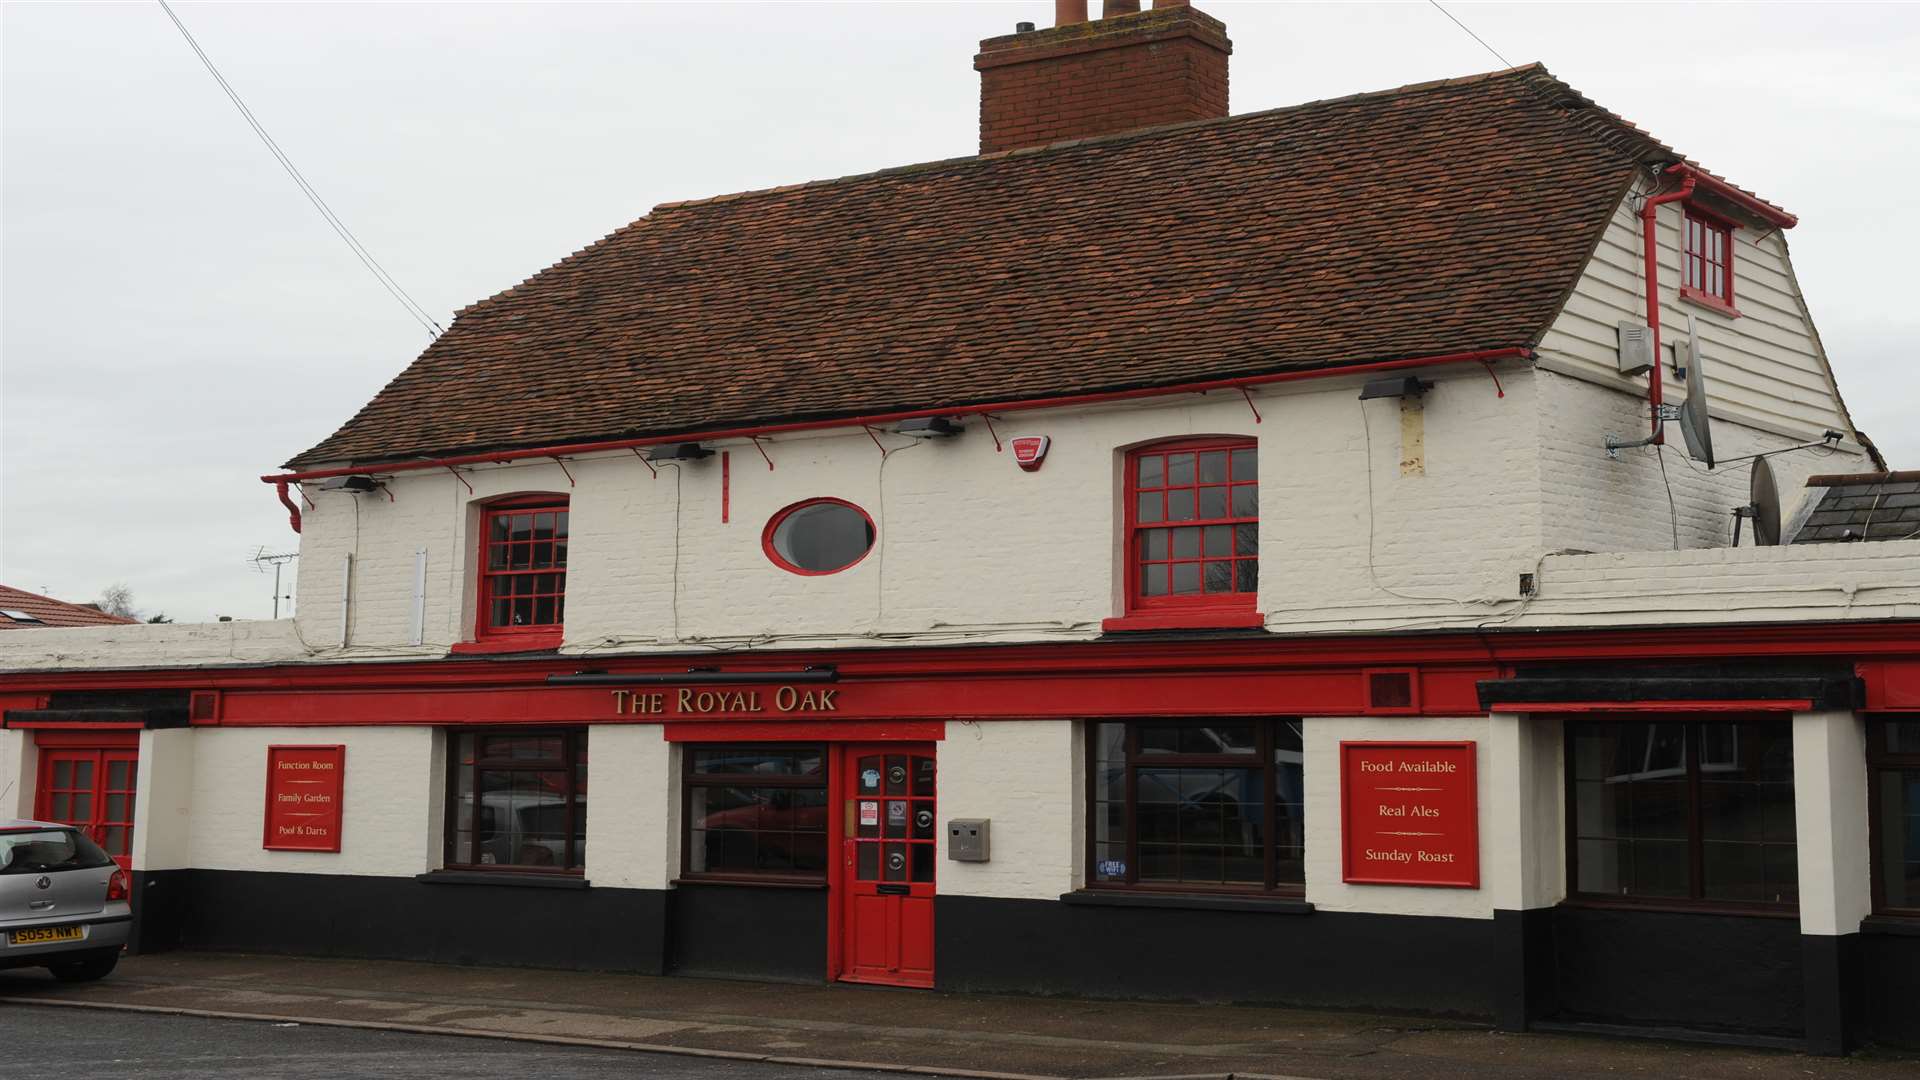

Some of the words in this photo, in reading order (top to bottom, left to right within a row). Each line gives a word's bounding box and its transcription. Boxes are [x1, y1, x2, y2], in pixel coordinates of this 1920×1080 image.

[611, 690, 663, 714] THE
[676, 688, 761, 713] ROYAL
[775, 686, 837, 712] OAK
[278, 761, 310, 769] Function
[312, 761, 333, 769] Room
[1361, 761, 1393, 772] Food
[1398, 761, 1457, 773] Available
[278, 793, 301, 804] Family
[304, 794, 330, 802] Garden
[1379, 805, 1406, 817] Real
[1410, 806, 1440, 817] Ales
[279, 826, 295, 835] Pool
[297, 826, 304, 835] &
[306, 826, 327, 835] Darts
[1366, 849, 1412, 864] Sunday
[1418, 851, 1454, 863] Roast
